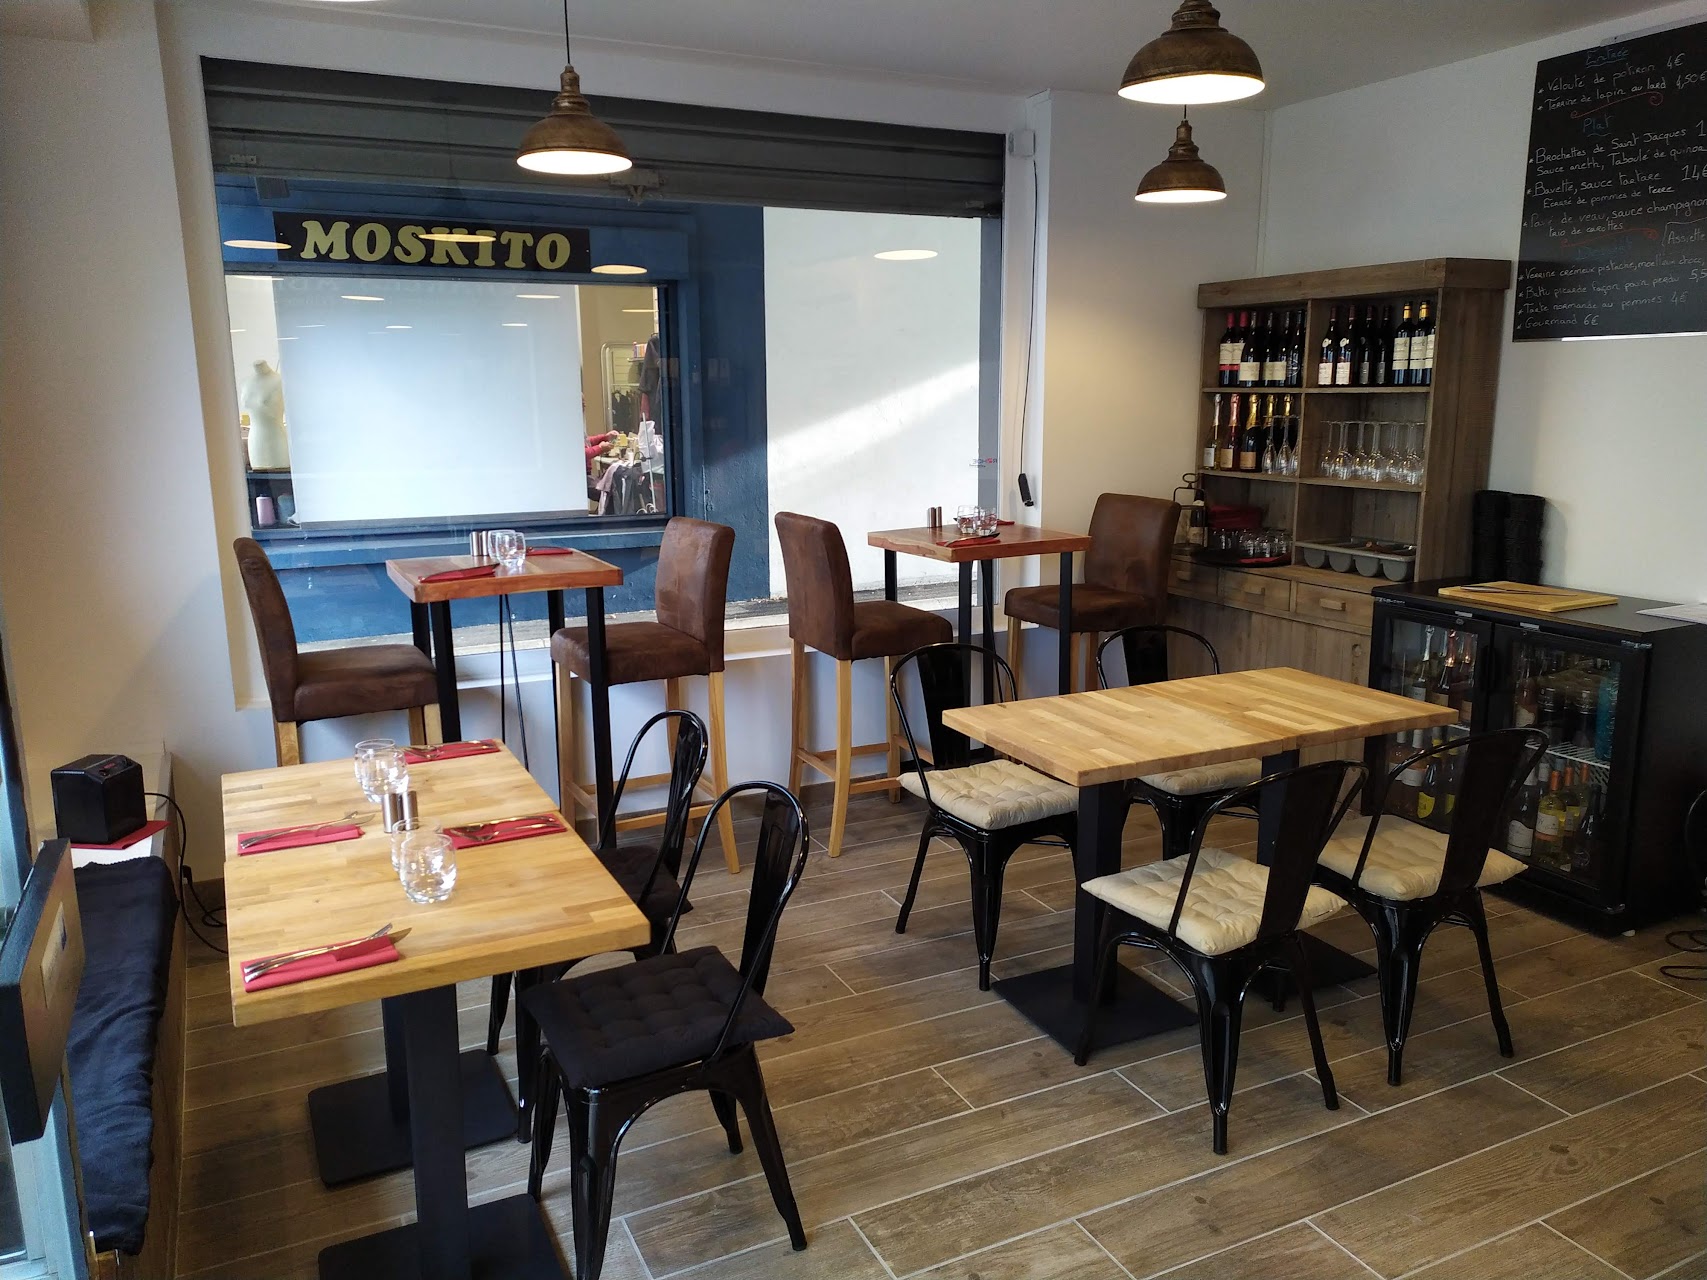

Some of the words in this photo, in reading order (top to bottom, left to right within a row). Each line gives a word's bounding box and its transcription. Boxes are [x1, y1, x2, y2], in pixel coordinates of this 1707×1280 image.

[1548, 74, 1587, 92] Velouté
[1593, 73, 1606, 84] de
[1612, 63, 1656, 87] potiron
[1667, 53, 1685, 70] 4€
[1544, 96, 1577, 111] Terrine
[1580, 94, 1592, 103] de
[1596, 89, 1627, 103] lapin
[1631, 84, 1643, 92] au
[1647, 77, 1667, 90] lard
[1582, 114, 1614, 133] Plat
[1535, 147, 1587, 164] Brochettes
[1592, 143, 1606, 154] de
[1611, 132, 1640, 150] Saint
[1643, 128, 1687, 146] Jacques
[1536, 165, 1565, 177] Sauce
[1607, 149, 1649, 167] Taboulé
[1653, 148, 1667, 159] de
[1532, 179, 1578, 197] Bavette,
[1580, 178, 1613, 191] sauce
[1618, 169, 1662, 187] tartare
[1576, 194, 1588, 205] de
[1590, 191, 1628, 207] pommes
[1631, 189, 1642, 198] de
[1648, 184, 1676, 195] terre
[1561, 211, 1573, 224] de
[1611, 206, 1643, 219] sauce
[1548, 225, 1566, 237] trio
[1570, 226, 1582, 235] de
[1586, 220, 1623, 233] carottes
[1667, 227, 1706, 245] Assiette
[300, 220, 571, 270] MOSKITO
[1525, 266, 1556, 280] Verrine
[1559, 264, 1596, 277] crémeux
[1592, 280, 1620, 296] façon
[1624, 279, 1649, 292] pain
[1652, 273, 1680, 288] perdu
[1523, 302, 1550, 314] Tarte
[1552, 300, 1598, 310] normande
[1621, 295, 1663, 311] pommes
[1525, 313, 1578, 329] Gourmand
[1583, 313, 1600, 327] 6€
